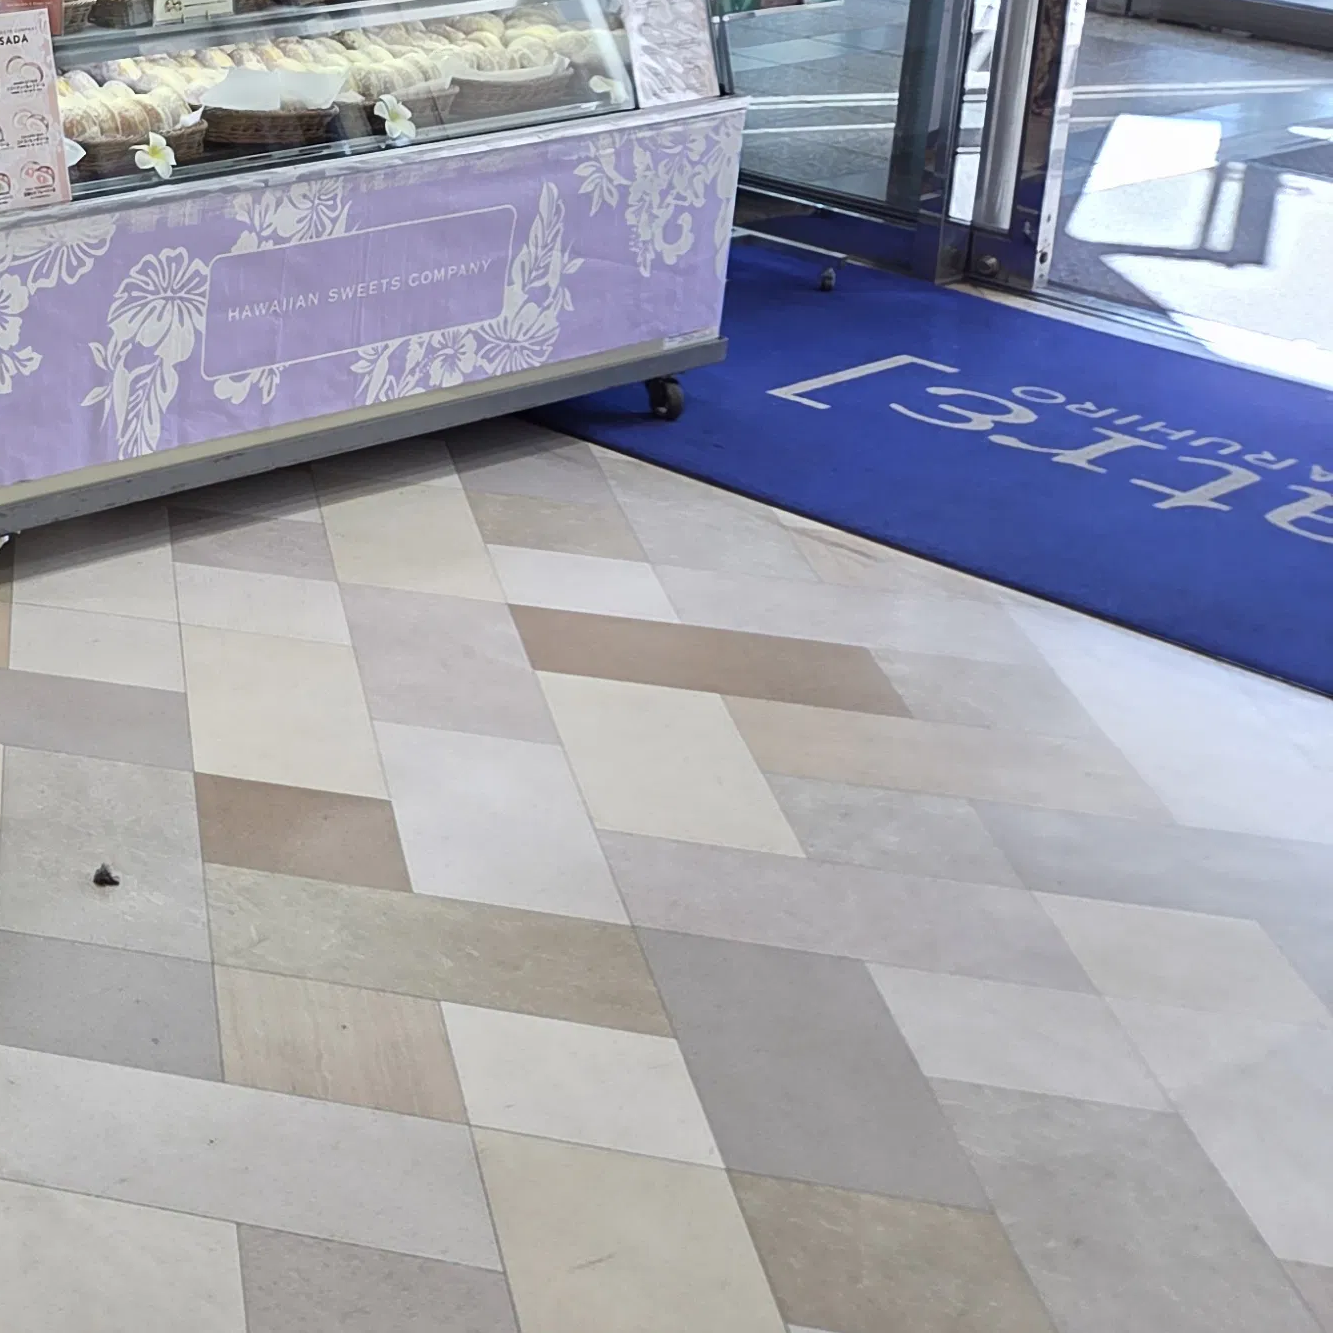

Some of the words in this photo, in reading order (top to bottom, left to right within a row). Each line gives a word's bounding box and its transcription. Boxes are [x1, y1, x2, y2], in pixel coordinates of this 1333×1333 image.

[227, 290, 320, 322] HAWAIIAN
[327, 275, 403, 303] SWEETS
[408, 258, 492, 287] COMPANY
